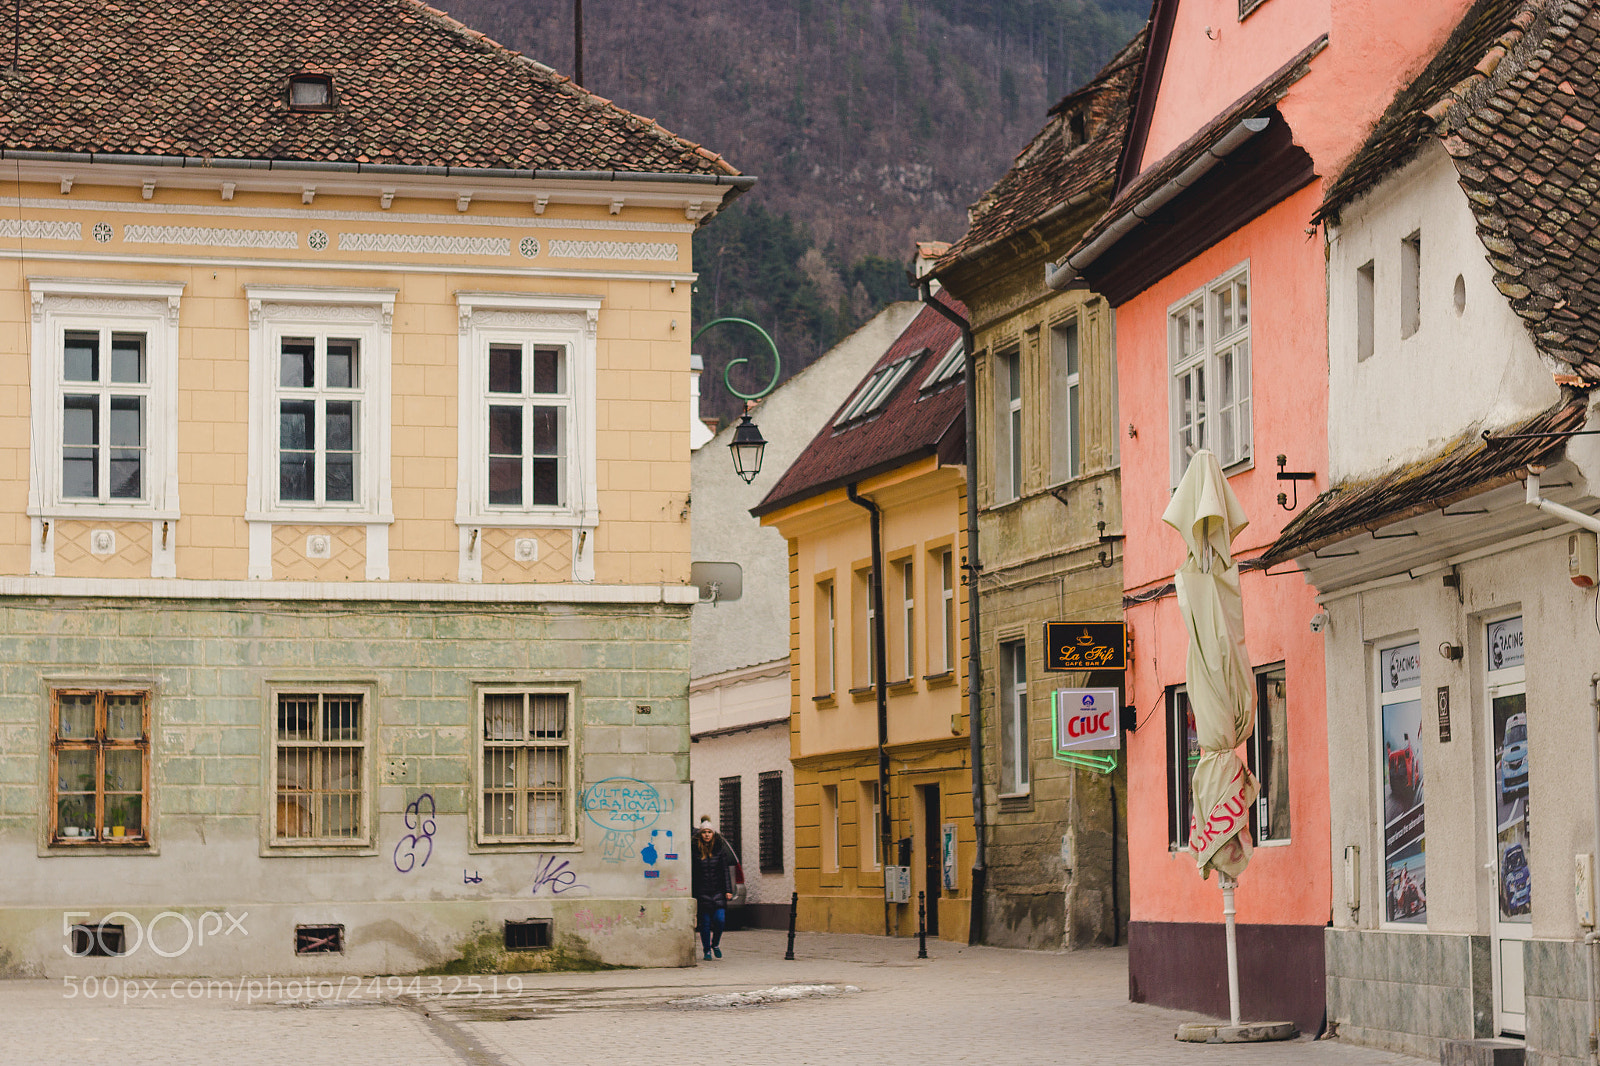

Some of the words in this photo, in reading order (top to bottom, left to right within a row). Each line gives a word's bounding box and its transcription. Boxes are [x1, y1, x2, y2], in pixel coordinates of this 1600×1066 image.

[1059, 646, 1080, 660] La
[1084, 646, 1114, 665] Fifi
[587, 798, 661, 813] CRAIOVA
[609, 810, 645, 824] 2004
[599, 830, 635, 860] 1948
